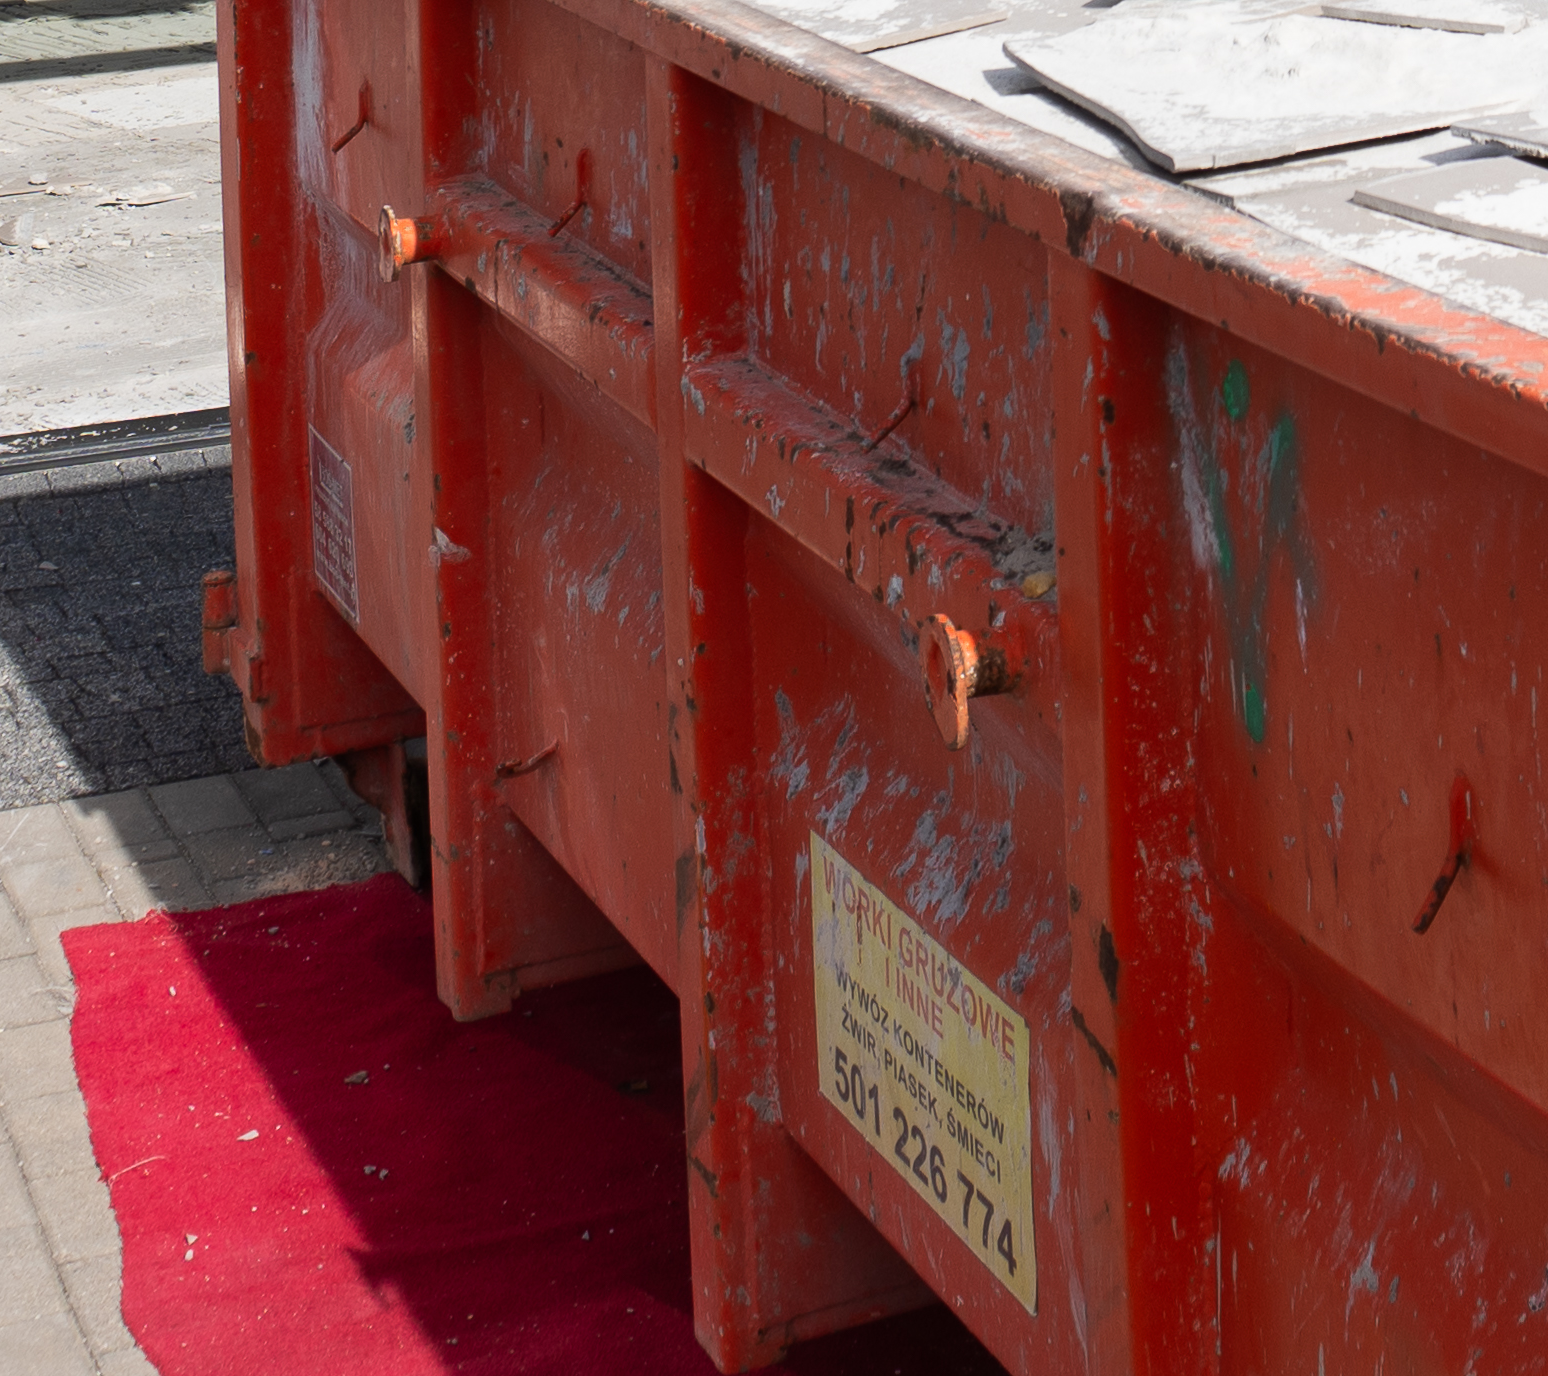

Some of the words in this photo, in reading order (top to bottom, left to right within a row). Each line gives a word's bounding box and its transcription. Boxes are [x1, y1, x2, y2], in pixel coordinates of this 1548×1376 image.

[822, 854, 893, 951] WORKI
[898, 926, 1016, 1061] GRUZOWE
[895, 968, 944, 1039] INNE
[835, 963, 890, 1035] WYWÓZ
[893, 1017, 1005, 1146] KONTENERÓW
[883, 1049, 943, 1130] PIASEK,
[946, 1104, 1001, 1185] ŚMIECI
[834, 1045, 881, 1137] 501
[893, 1105, 948, 1205] 226
[957, 1172, 1017, 1277] 774
